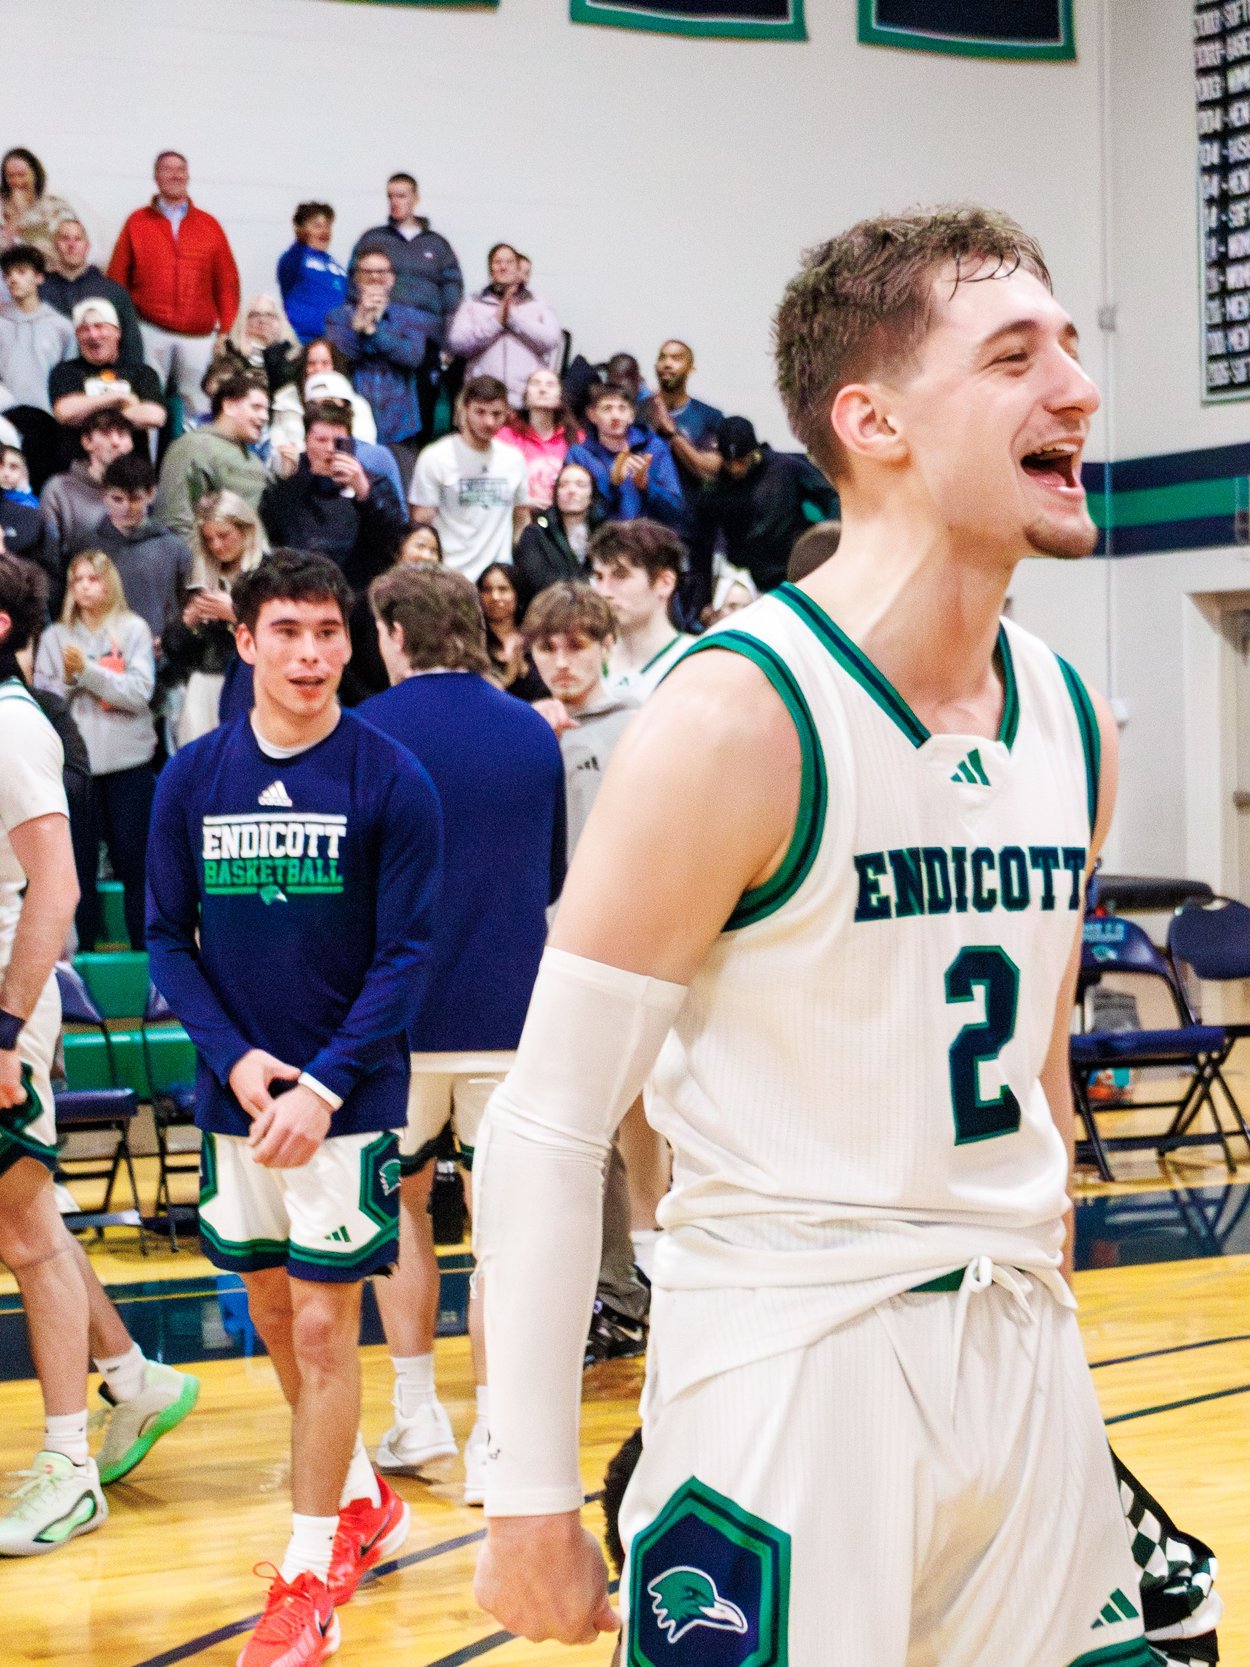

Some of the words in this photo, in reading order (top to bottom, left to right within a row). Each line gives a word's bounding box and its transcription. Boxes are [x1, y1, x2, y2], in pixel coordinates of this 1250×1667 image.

[202, 822, 347, 860] ENDICOTT
[204, 857, 344, 885] BASKETBALL
[853, 845, 1087, 923] ENDICOTT
[944, 944, 1021, 1147] 2
